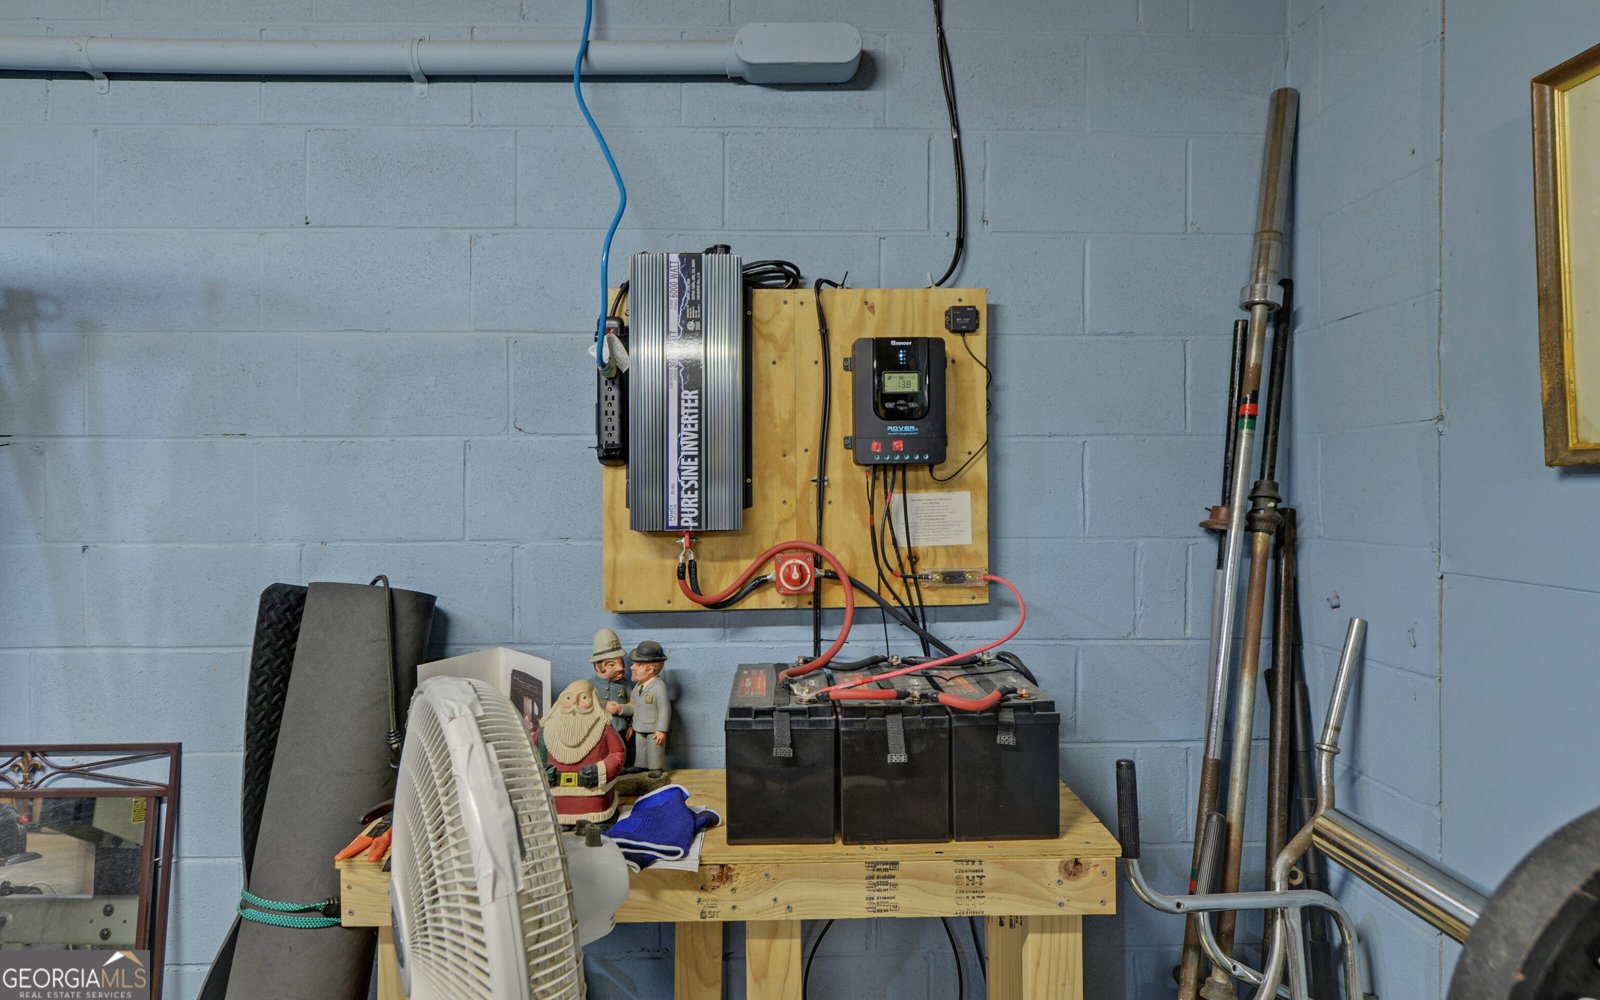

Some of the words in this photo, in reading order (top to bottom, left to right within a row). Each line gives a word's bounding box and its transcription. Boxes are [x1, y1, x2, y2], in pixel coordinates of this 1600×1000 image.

[669, 260, 678, 279] WATT
[669, 281, 678, 298] 6000
[680, 390, 698, 456] INVERTER
[680, 456, 698, 488] SINE
[680, 490, 698, 526] PURE
